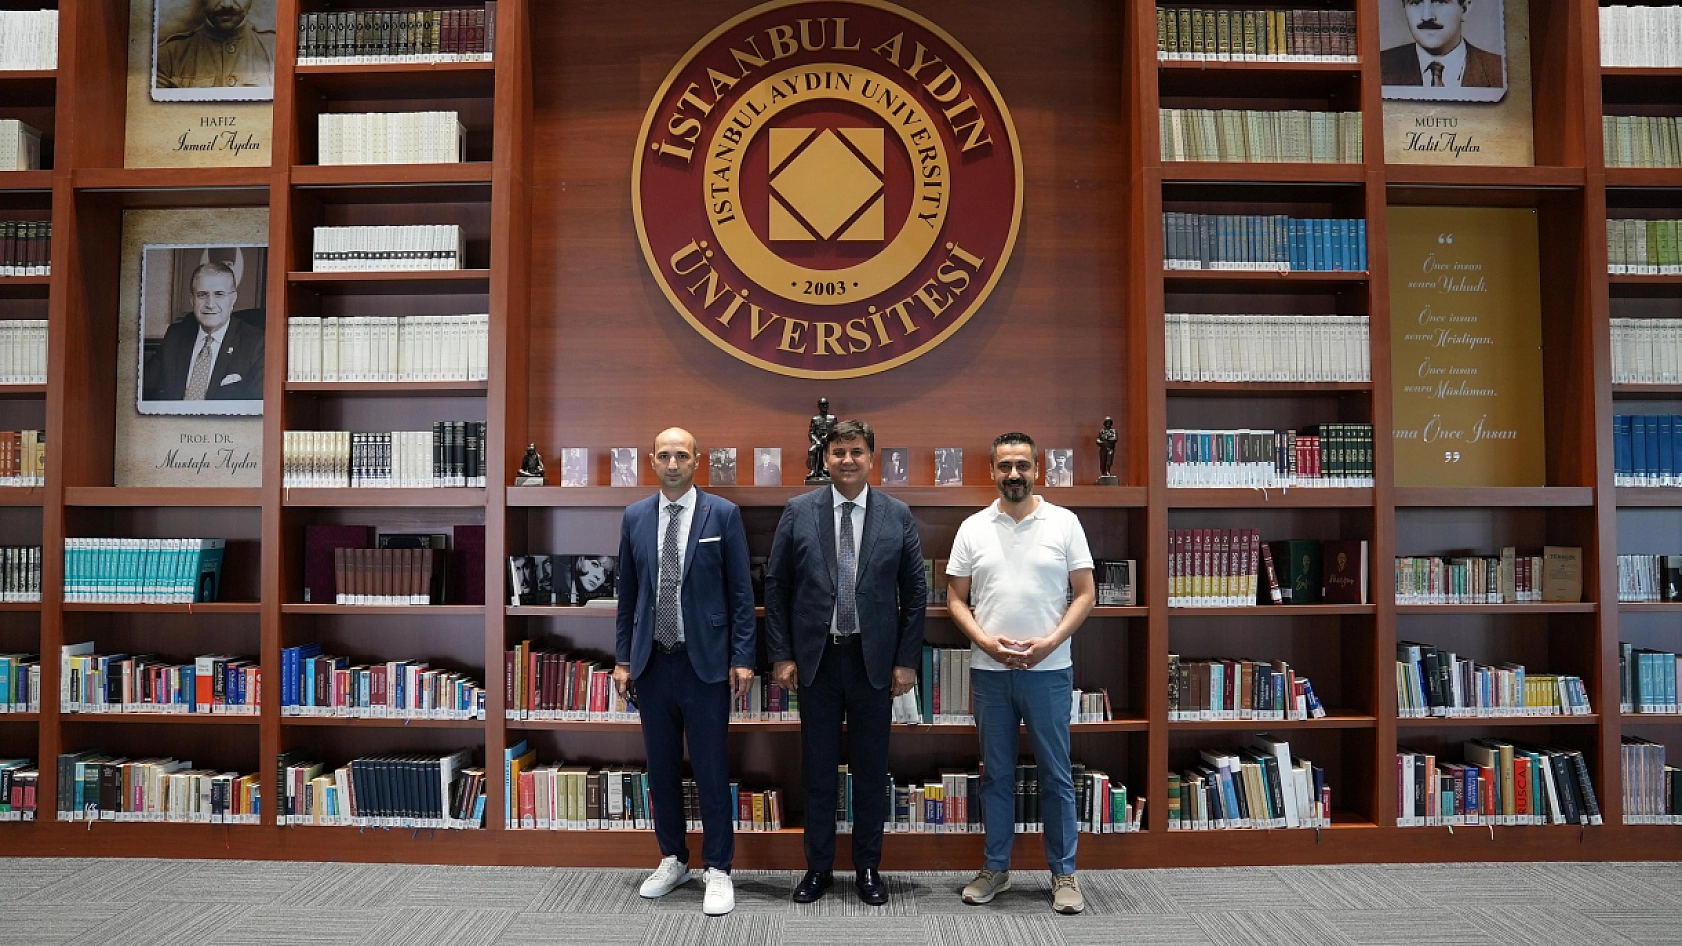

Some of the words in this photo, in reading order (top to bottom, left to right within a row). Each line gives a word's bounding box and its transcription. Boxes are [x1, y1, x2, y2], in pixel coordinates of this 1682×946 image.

[651, 17, 861, 164] İSTANBUL
[875, 31, 993, 155] AYDIN
[200, 116, 236, 127] HAFIZ
[1415, 115, 1458, 128] MÜFTÜ
[172, 128, 219, 151] İsmail
[219, 130, 260, 156] Aydın
[711, 100, 768, 225] ISTANBUL
[770, 72, 853, 104] AYDIN
[862, 79, 943, 229] UNIVERSITY
[1403, 132, 1439, 152] Halit
[1439, 132, 1480, 158] Aydın
[1422, 253, 1450, 274] Önce
[1453, 260, 1482, 271] insan
[803, 280, 847, 296] 2003
[1408, 281, 1436, 289] sonra
[669, 238, 985, 356] ÜNİVERSİTESİ
[1418, 305, 1446, 326] Önce
[1449, 312, 1478, 323] insan
[1404, 333, 1434, 341] sonra
[1418, 357, 1446, 378] Önce
[1449, 364, 1478, 375] insan
[1403, 385, 1432, 393] sonra
[1423, 414, 1464, 443] Önce
[1466, 414, 1518, 443] İnsan
[155, 448, 211, 475] Mustafa
[214, 448, 257, 475] Aydın
